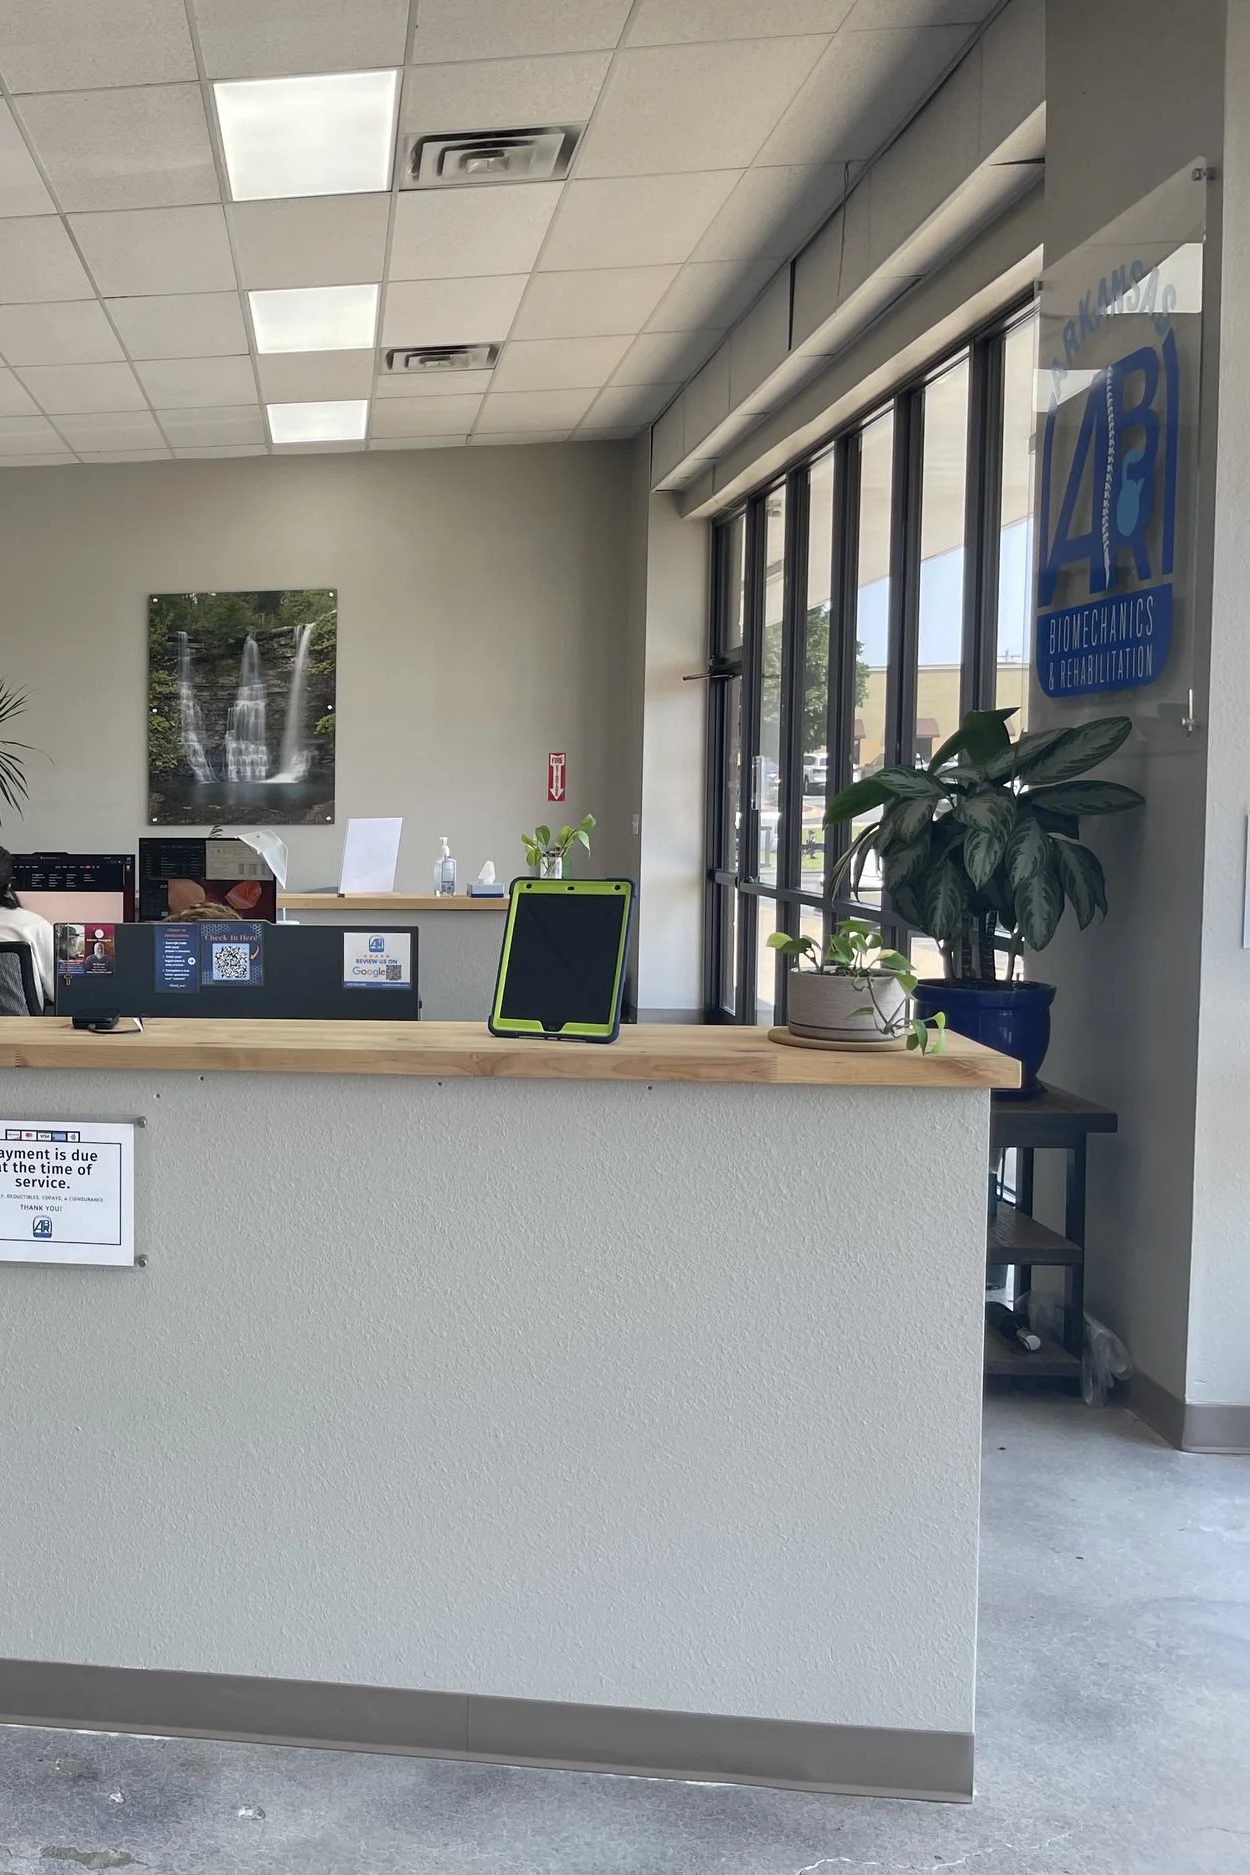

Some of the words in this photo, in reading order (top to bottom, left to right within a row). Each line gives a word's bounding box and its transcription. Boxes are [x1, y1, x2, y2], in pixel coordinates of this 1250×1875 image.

[1049, 596, 1154, 656] BIOMECHANICS
[1049, 664, 1055, 690] &
[1060, 645, 1154, 688] REHABILITATION
[352, 967, 385, 977] Google
[55, 1148, 67, 1161] is
[71, 1149, 98, 1162] due
[13, 1162, 36, 1174] the
[41, 1162, 72, 1175] time
[78, 1163, 92, 1176] of
[15, 1176, 71, 1189] service.
